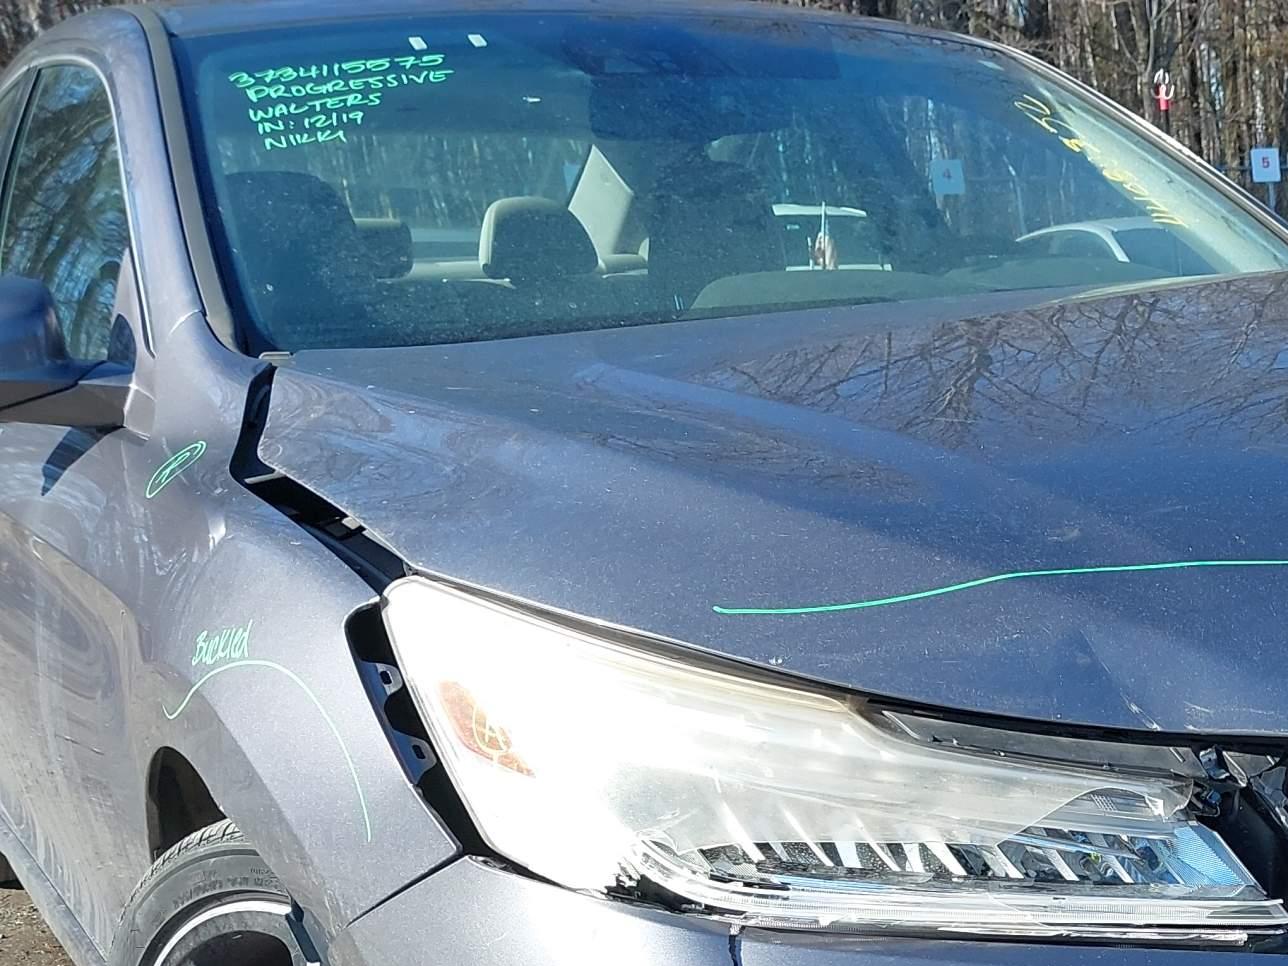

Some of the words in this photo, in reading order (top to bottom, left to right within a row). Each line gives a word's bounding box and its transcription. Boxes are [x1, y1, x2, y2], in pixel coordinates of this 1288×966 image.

[228, 54, 445, 88] 3734115575
[246, 70, 454, 102] PROGRESSIVE
[249, 92, 382, 122] WALTERS
[257, 119, 295, 136] IN:
[304, 111, 364, 128] 12/19
